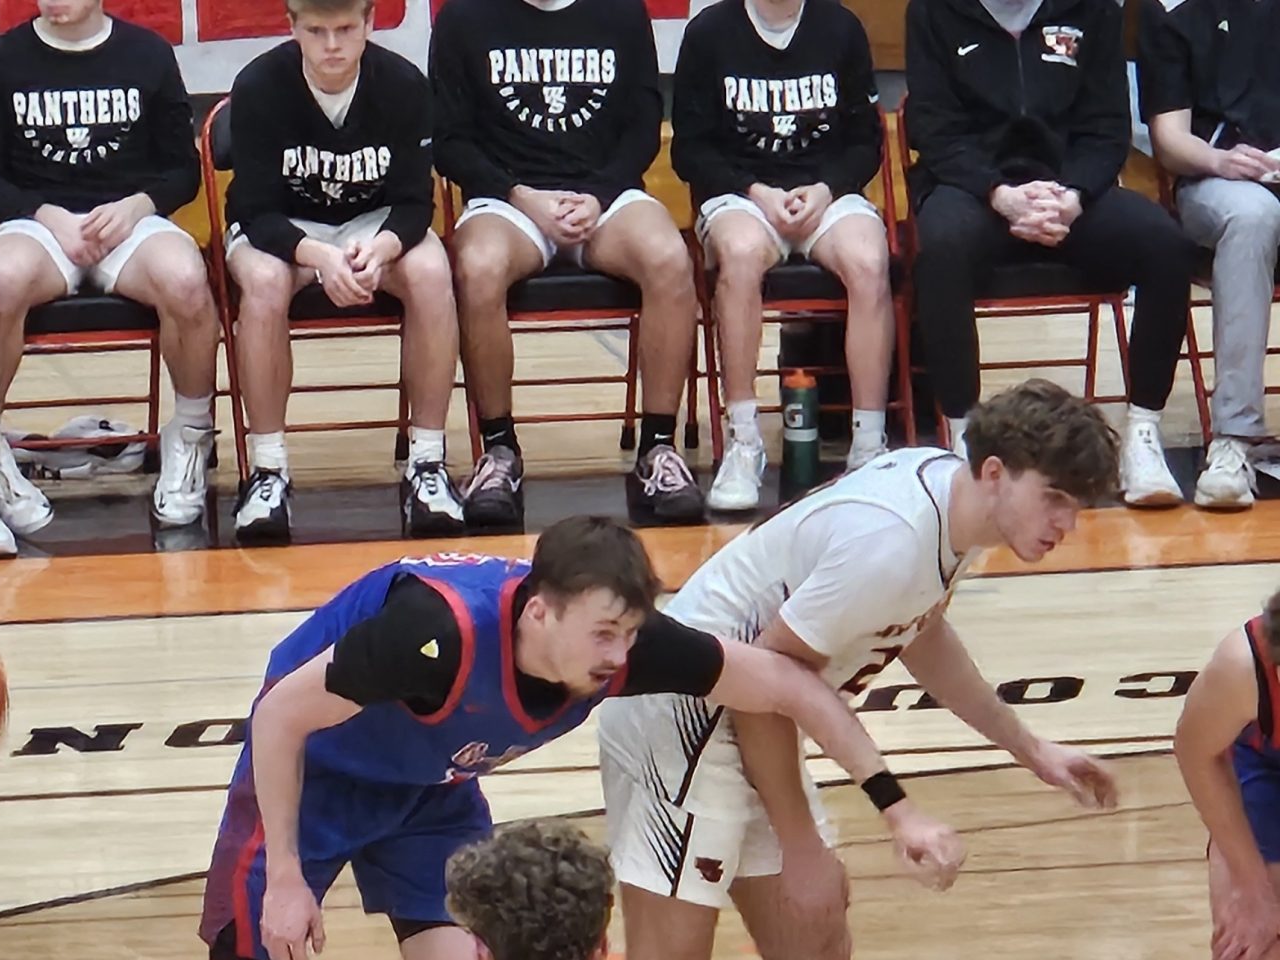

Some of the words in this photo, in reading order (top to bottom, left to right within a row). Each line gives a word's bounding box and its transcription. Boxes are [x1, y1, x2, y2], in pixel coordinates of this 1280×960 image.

[489, 48, 616, 85] PANTHERS
[13, 88, 141, 126] PANTHERS
[784, 403, 804, 428] G
